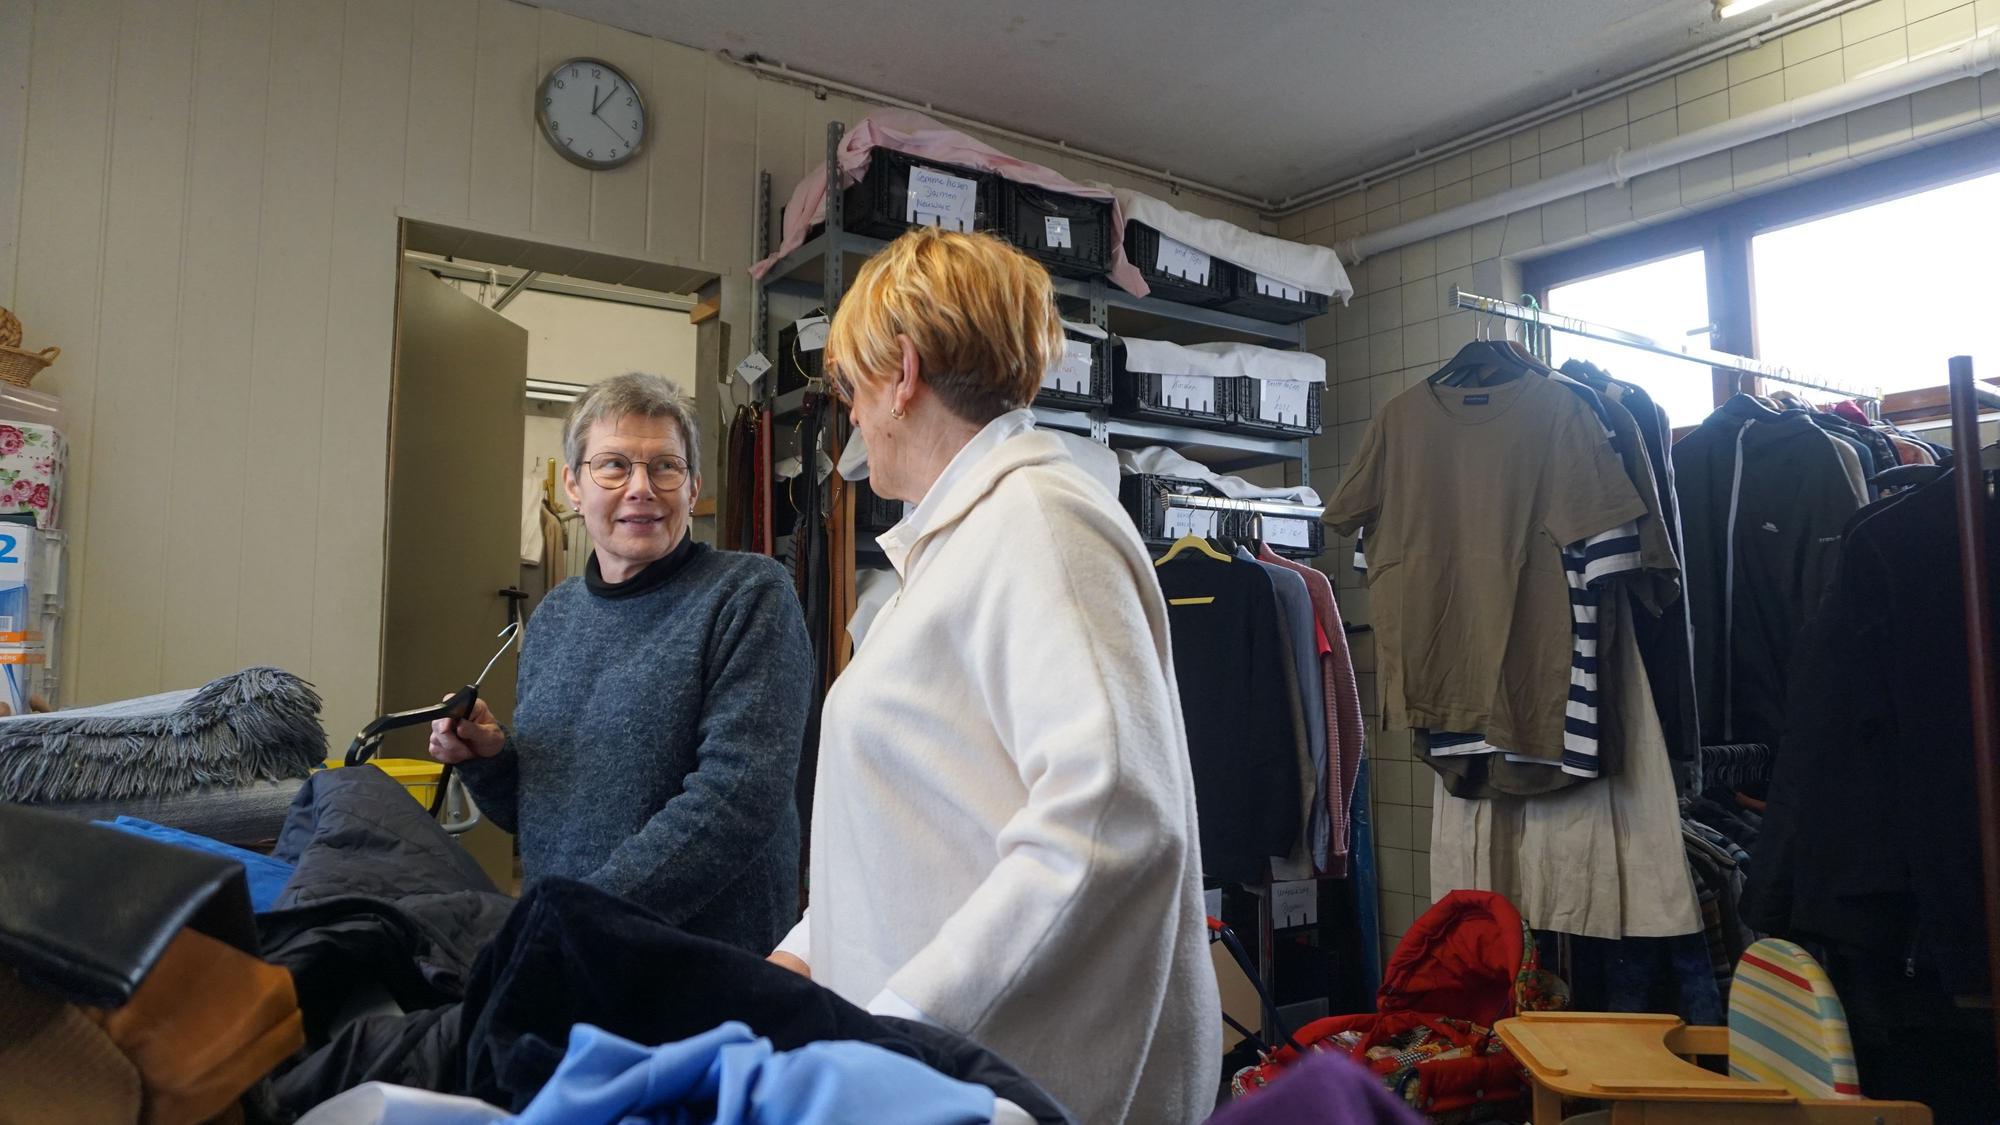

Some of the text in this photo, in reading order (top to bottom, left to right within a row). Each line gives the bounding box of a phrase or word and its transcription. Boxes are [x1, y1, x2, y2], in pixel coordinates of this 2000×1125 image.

[572, 68, 579, 79] 11
[591, 68, 601, 79] 12
[553, 79, 565, 90] 10
[545, 97, 552, 107] 9
[626, 97, 633, 107] 2
[552, 120, 559, 130] 8
[632, 120, 638, 129] 3
[566, 138, 574, 147] 7
[623, 140, 630, 149] 4
[587, 149, 594, 158] 6
[610, 149, 616, 158] 5
